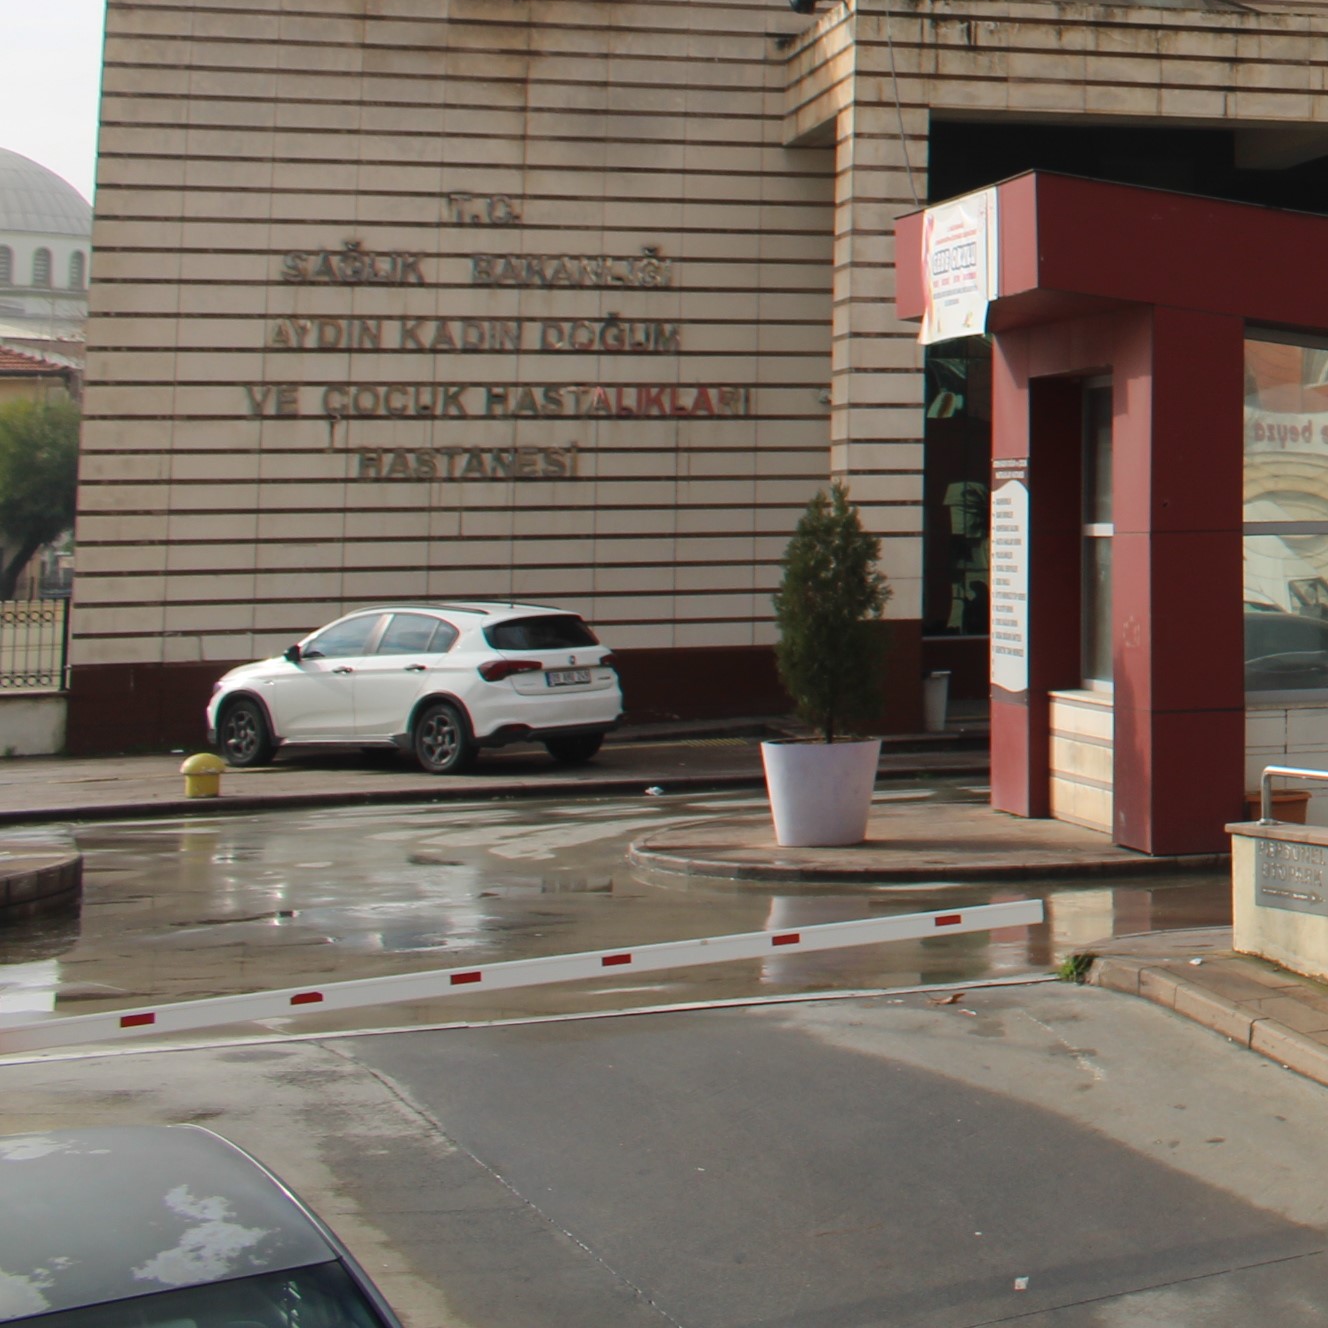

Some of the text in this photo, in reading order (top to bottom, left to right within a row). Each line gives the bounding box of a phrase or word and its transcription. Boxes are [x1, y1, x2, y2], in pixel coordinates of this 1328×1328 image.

[279, 241, 674, 288] SAĞLIK BAKANLIĞI
[267, 310, 681, 352] AYDIN KADIN DOĞUM
[245, 385, 749, 426] VE ÇOCUK HASTALIKLARI
[356, 440, 580, 479] HASTANESİ
